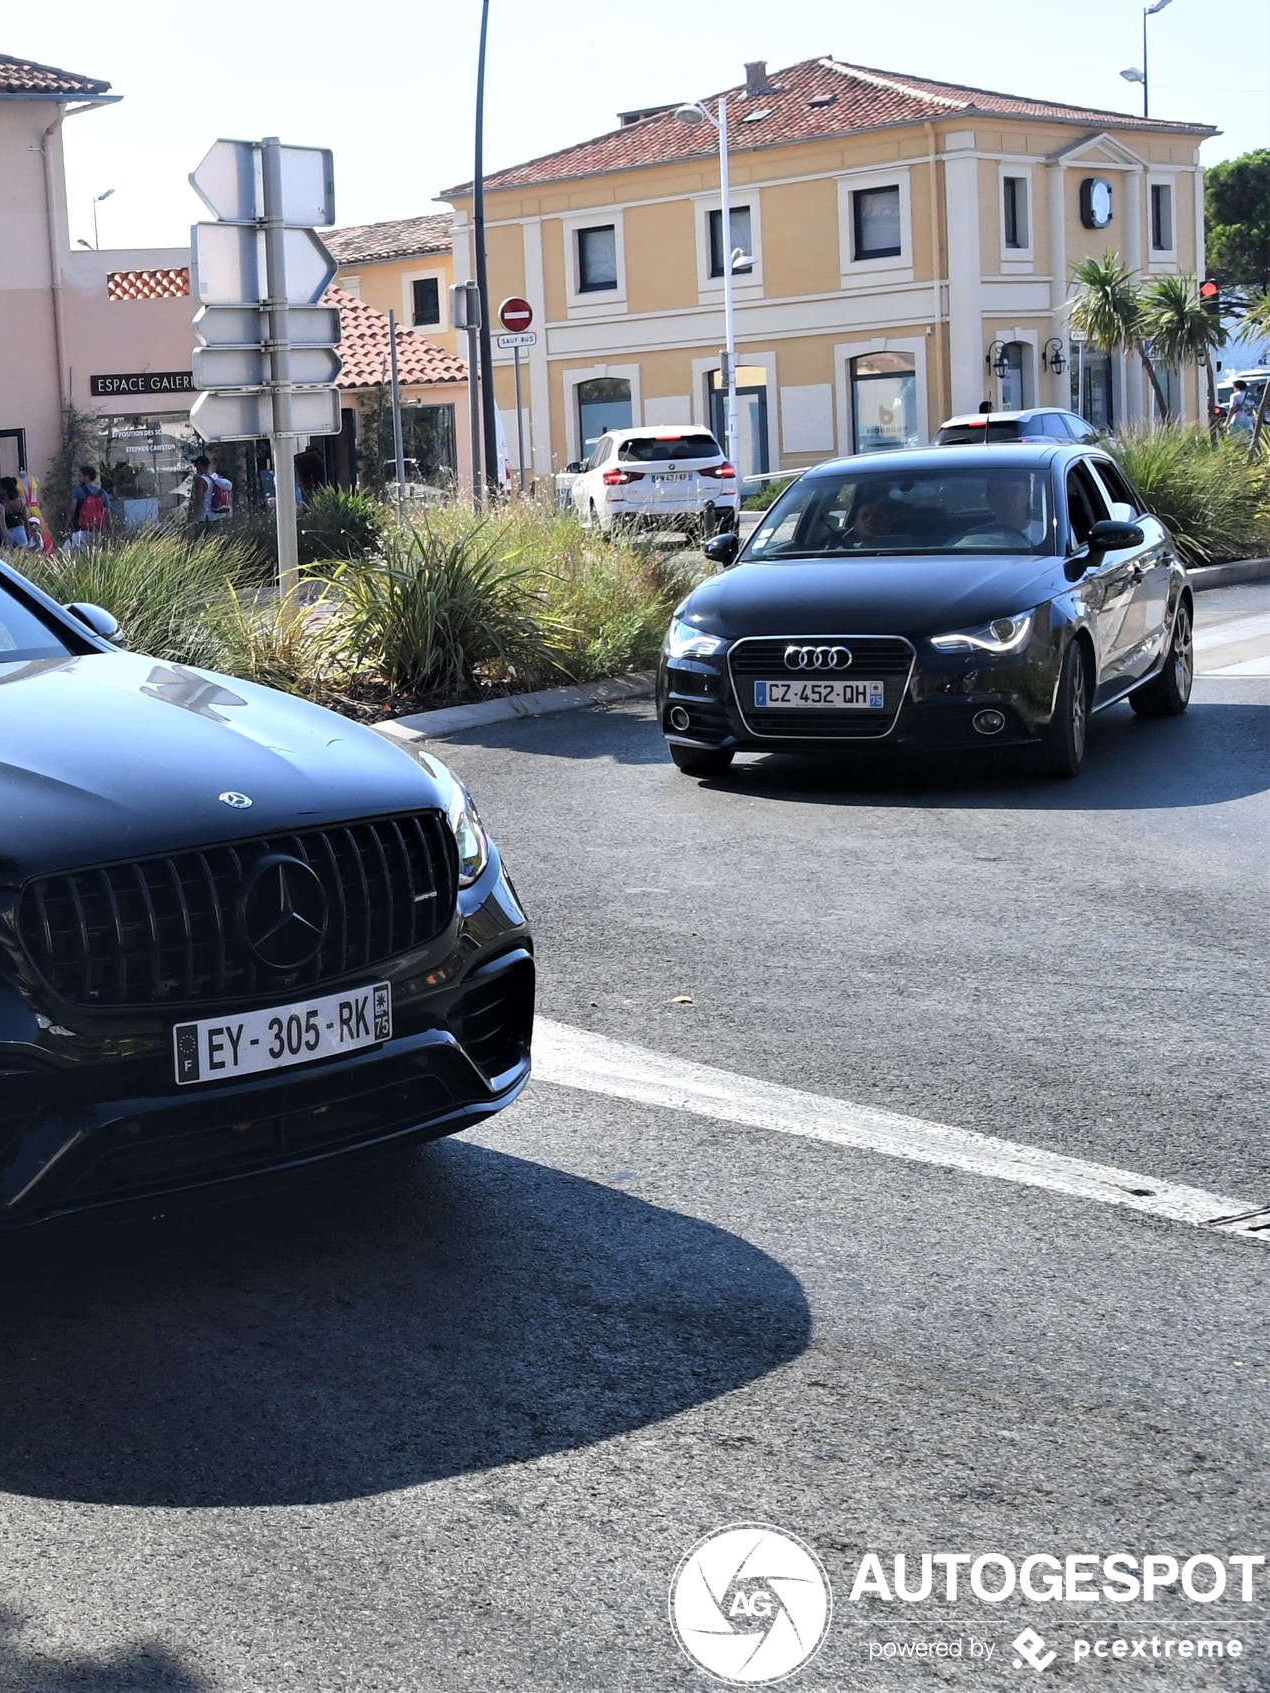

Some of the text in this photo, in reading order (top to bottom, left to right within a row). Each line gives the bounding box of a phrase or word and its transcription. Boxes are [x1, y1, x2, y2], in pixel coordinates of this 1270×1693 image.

[98, 378, 145, 392] ESPACE
[870, 696, 882, 705] 75
[184, 1060, 193, 1072] F
[374, 1018, 389, 1036] 75
